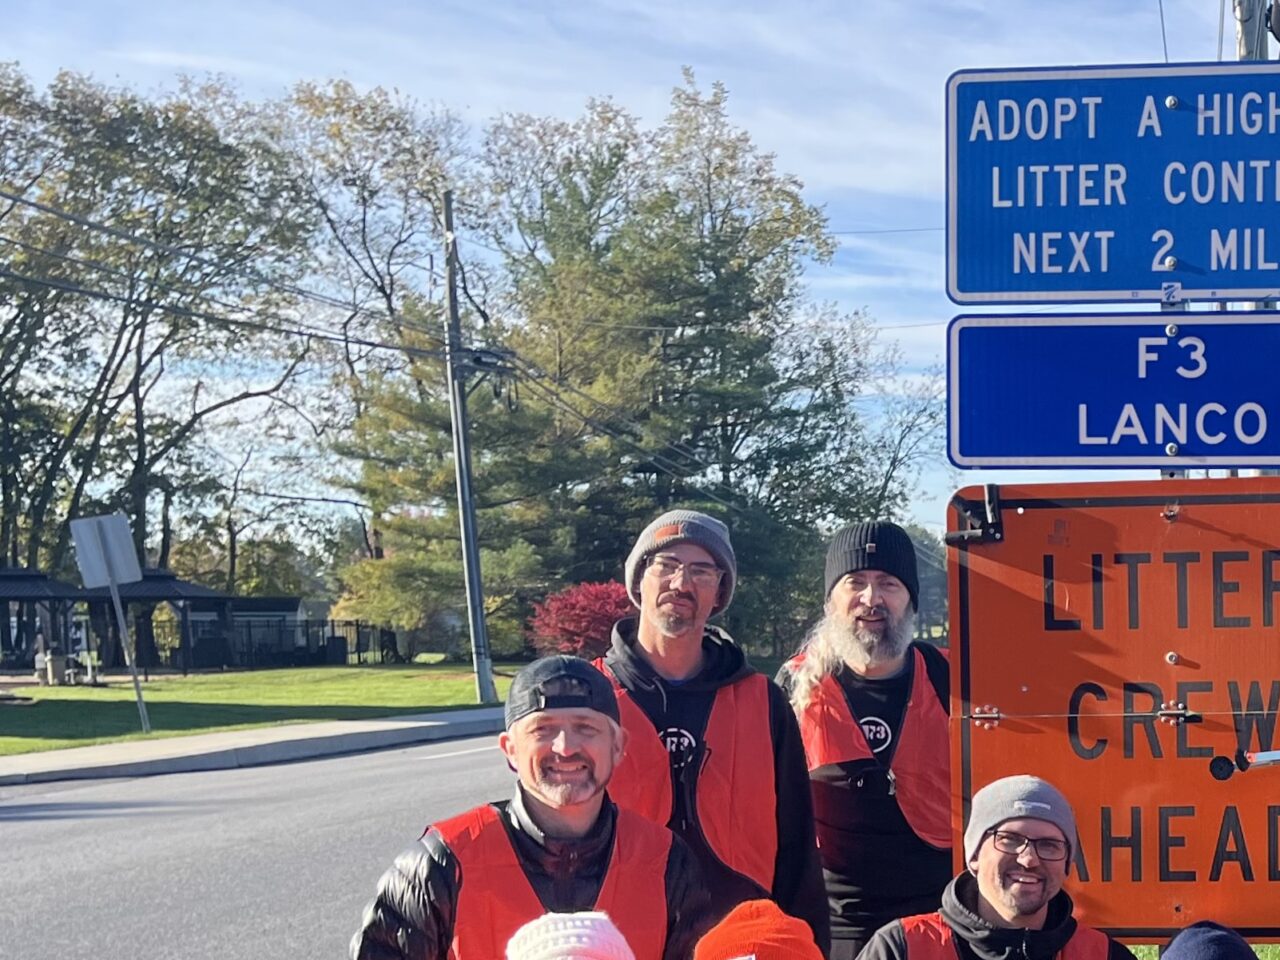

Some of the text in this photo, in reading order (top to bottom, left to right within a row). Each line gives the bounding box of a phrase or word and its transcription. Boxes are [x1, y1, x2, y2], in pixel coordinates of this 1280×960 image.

[969, 97, 1102, 142] ADOPT
[1137, 95, 1162, 137] A
[992, 163, 1128, 208] LITTER
[1013, 230, 1115, 274] NEXT
[1151, 229, 1175, 272] 2
[1138, 337, 1208, 379] F3
[1078, 401, 1268, 446] LANCO
